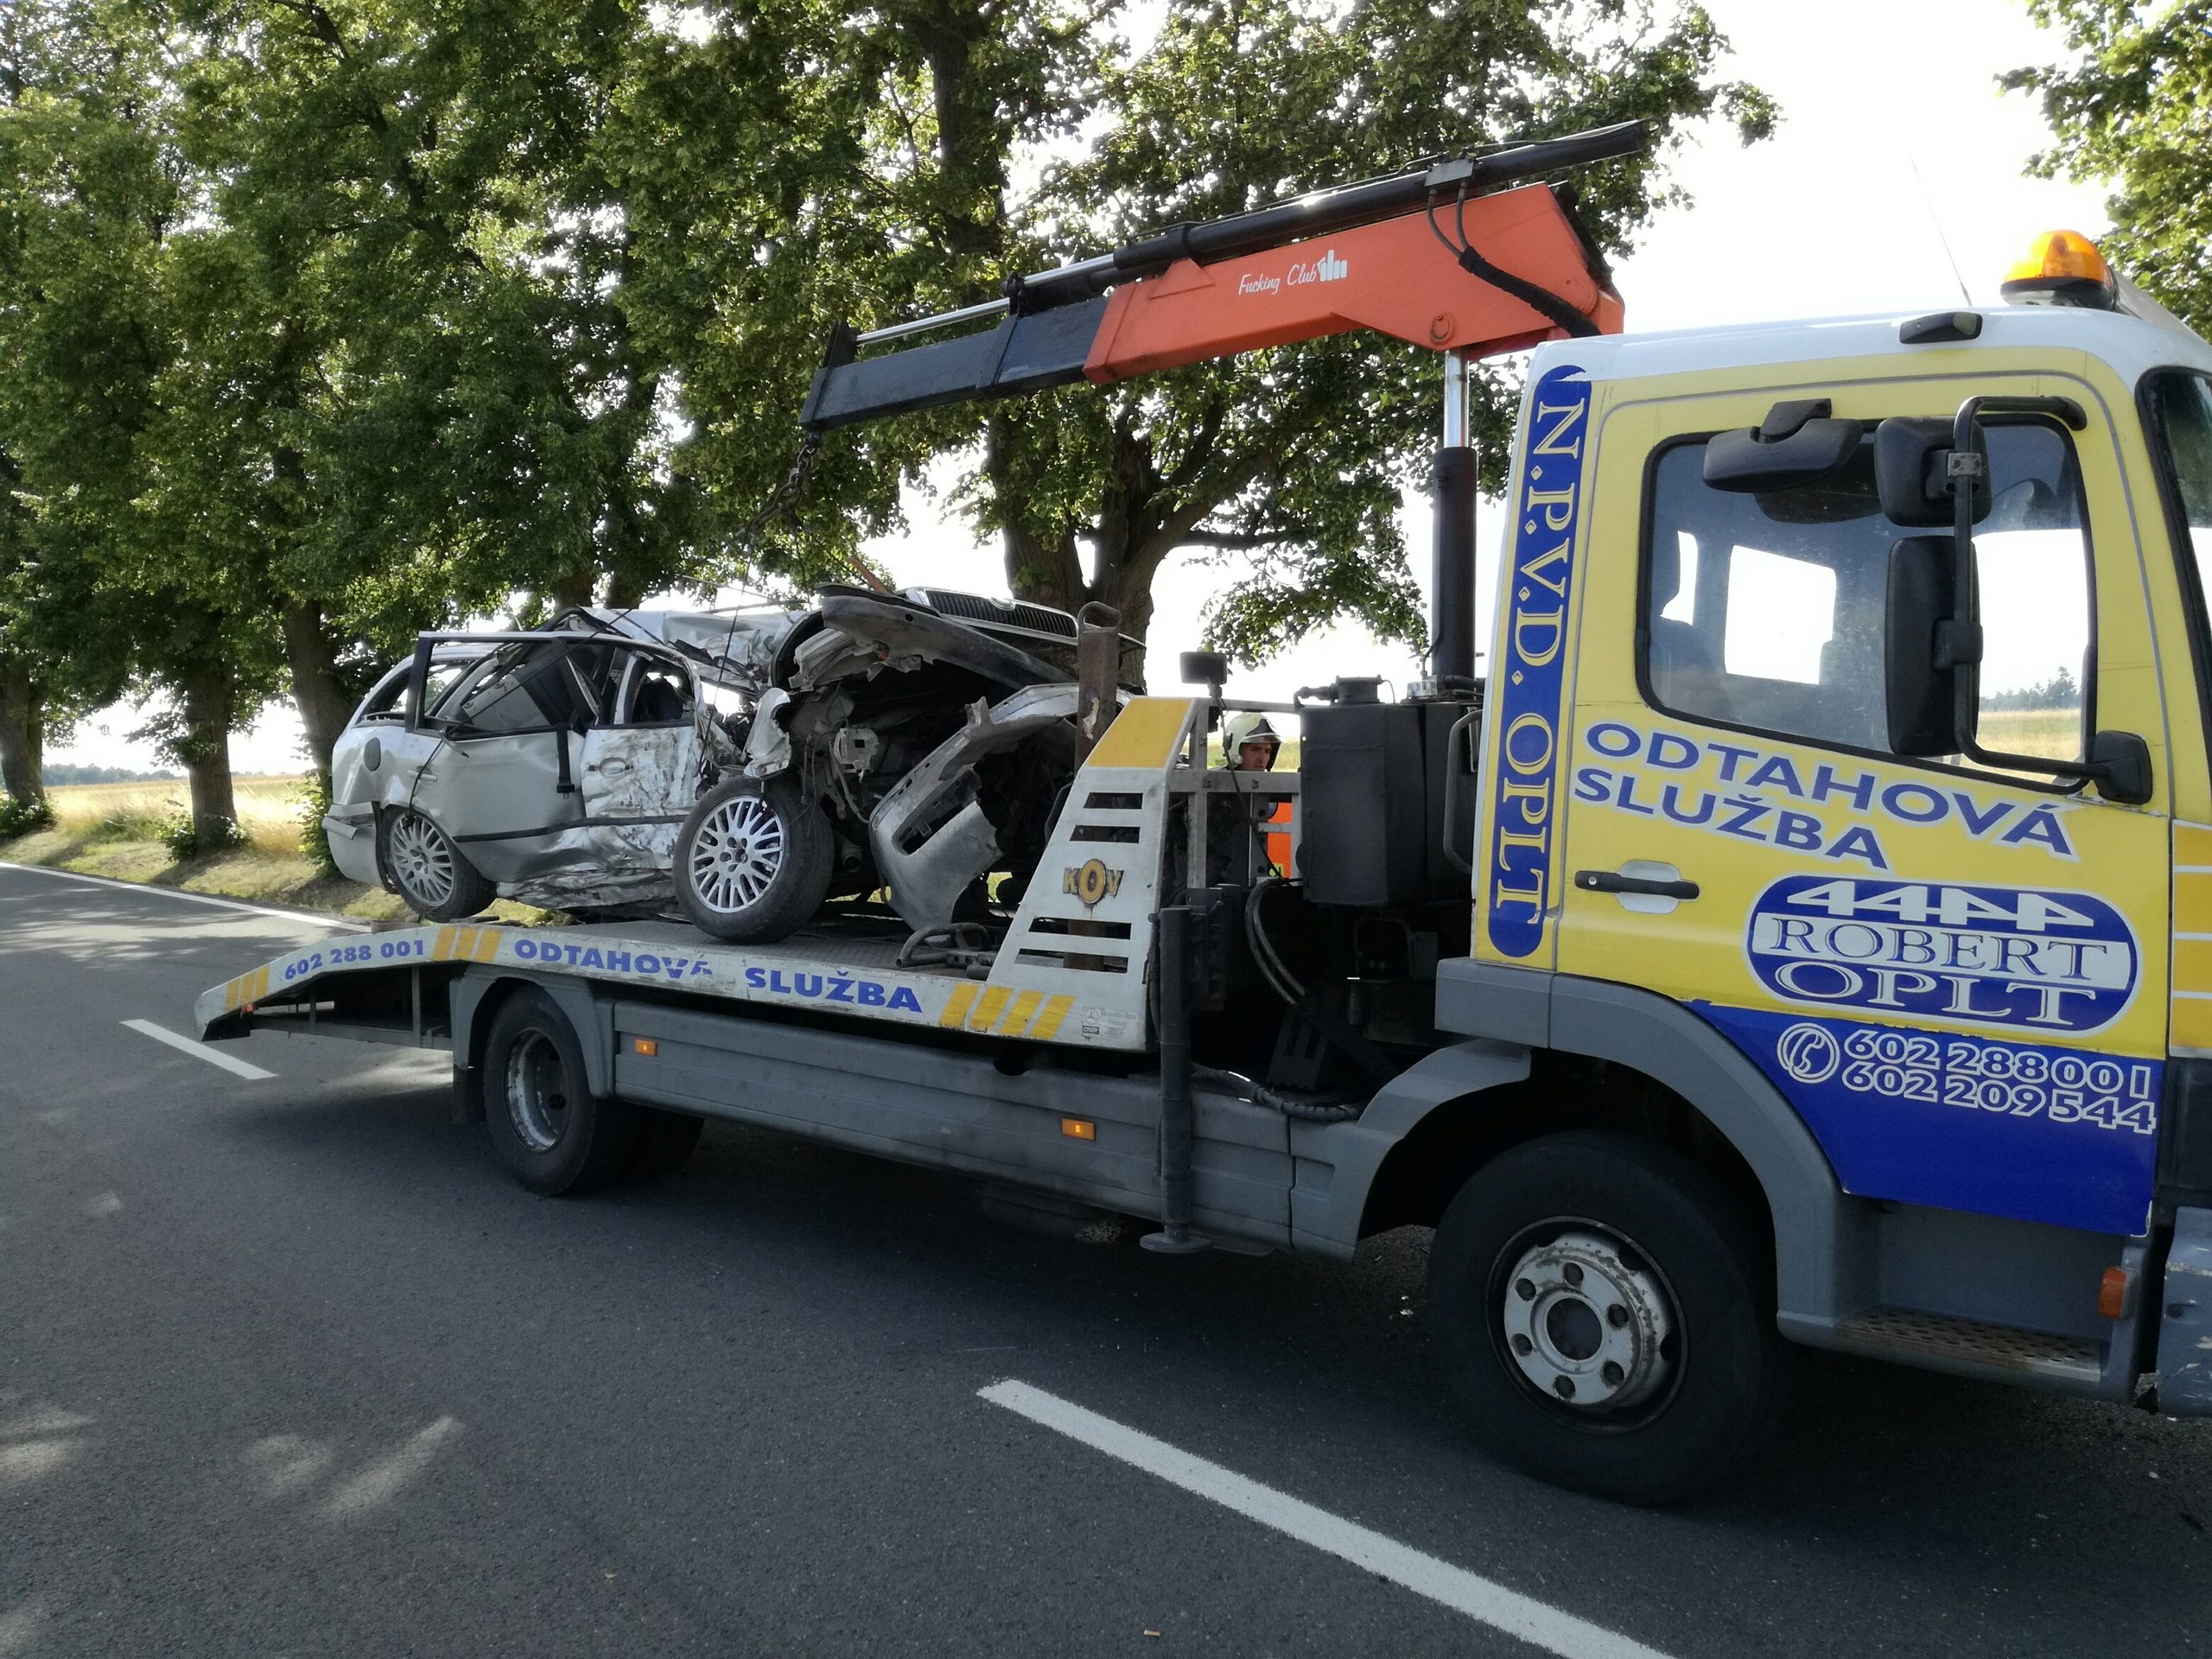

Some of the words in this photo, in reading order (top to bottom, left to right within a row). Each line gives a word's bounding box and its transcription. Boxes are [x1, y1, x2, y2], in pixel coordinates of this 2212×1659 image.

[1238, 274, 1281, 295] Fucking
[1287, 263, 1317, 286] Club
[1496, 713, 1553, 925] OPLT
[1574, 768, 1888, 869] SLUŽBA
[1586, 723, 2072, 857] ODTAHOVÁ
[1063, 858, 1124, 905] KOV
[284, 953, 322, 980] 602
[330, 945, 372, 963] 288
[380, 939, 423, 958] 001
[515, 939, 713, 979] ODTAHOVÁ
[745, 967, 923, 1014] SLUŽBA
[1770, 918, 2107, 981] ROBERT
[1775, 962, 2096, 1026] OPLT
